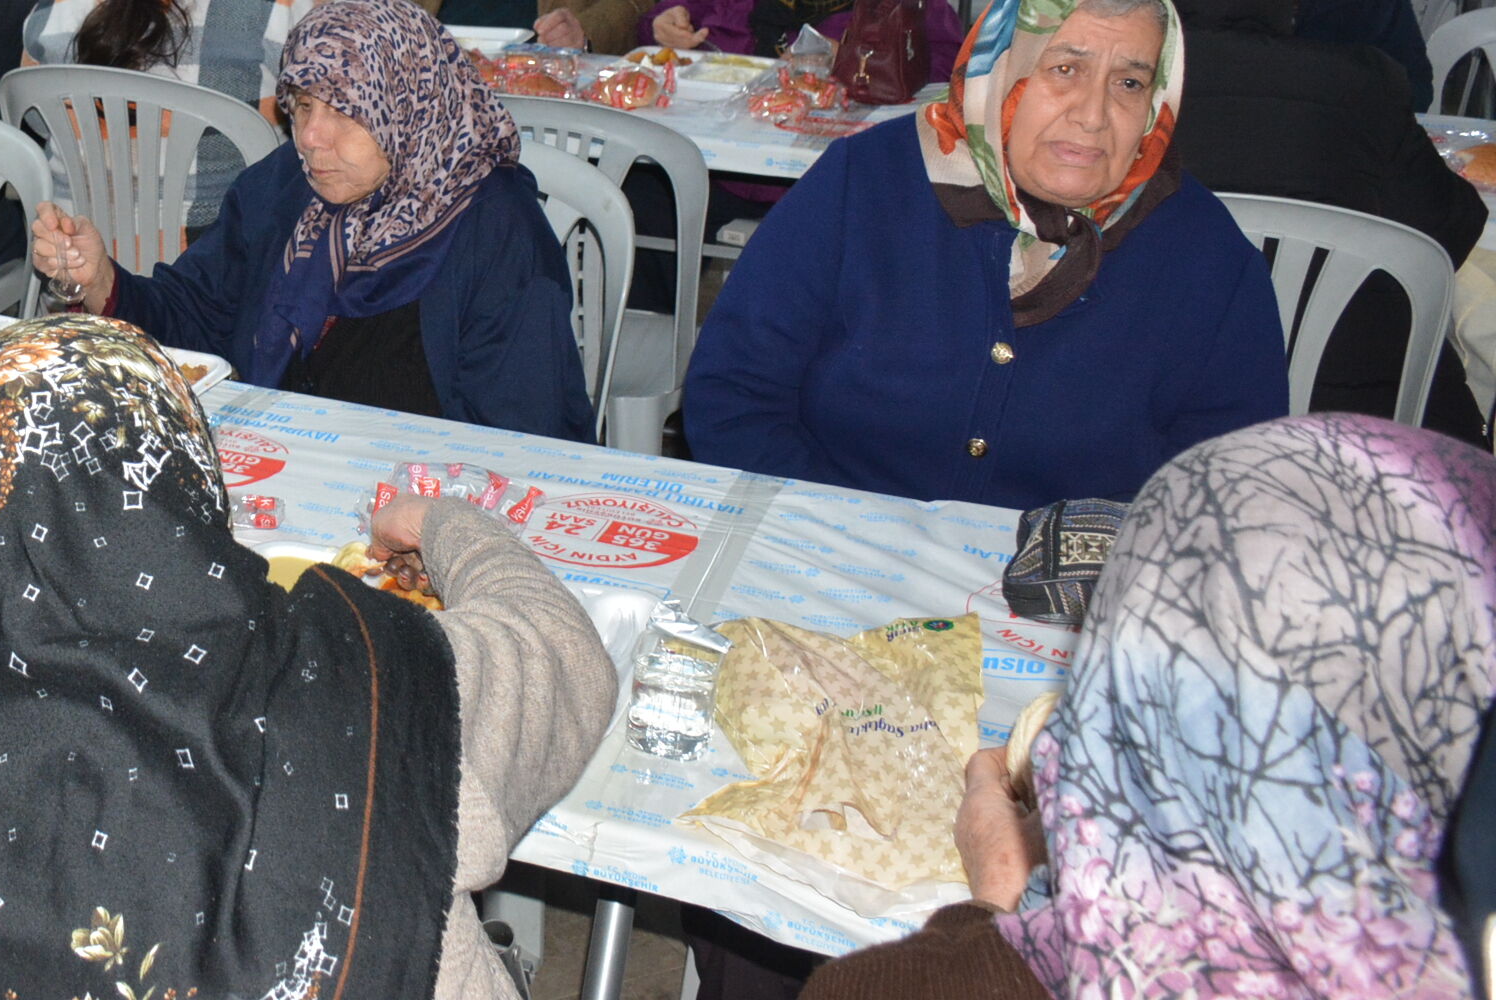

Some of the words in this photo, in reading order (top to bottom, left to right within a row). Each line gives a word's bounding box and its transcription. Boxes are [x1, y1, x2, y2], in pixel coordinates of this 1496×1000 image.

[547, 512, 597, 526] SAAT
[545, 521, 587, 535] 24
[617, 525, 671, 540] GÜN
[528, 534, 567, 556] İÇİN
[611, 534, 661, 550] 365
[571, 551, 637, 562] AYDIN
[984, 656, 1046, 674] Olsu
